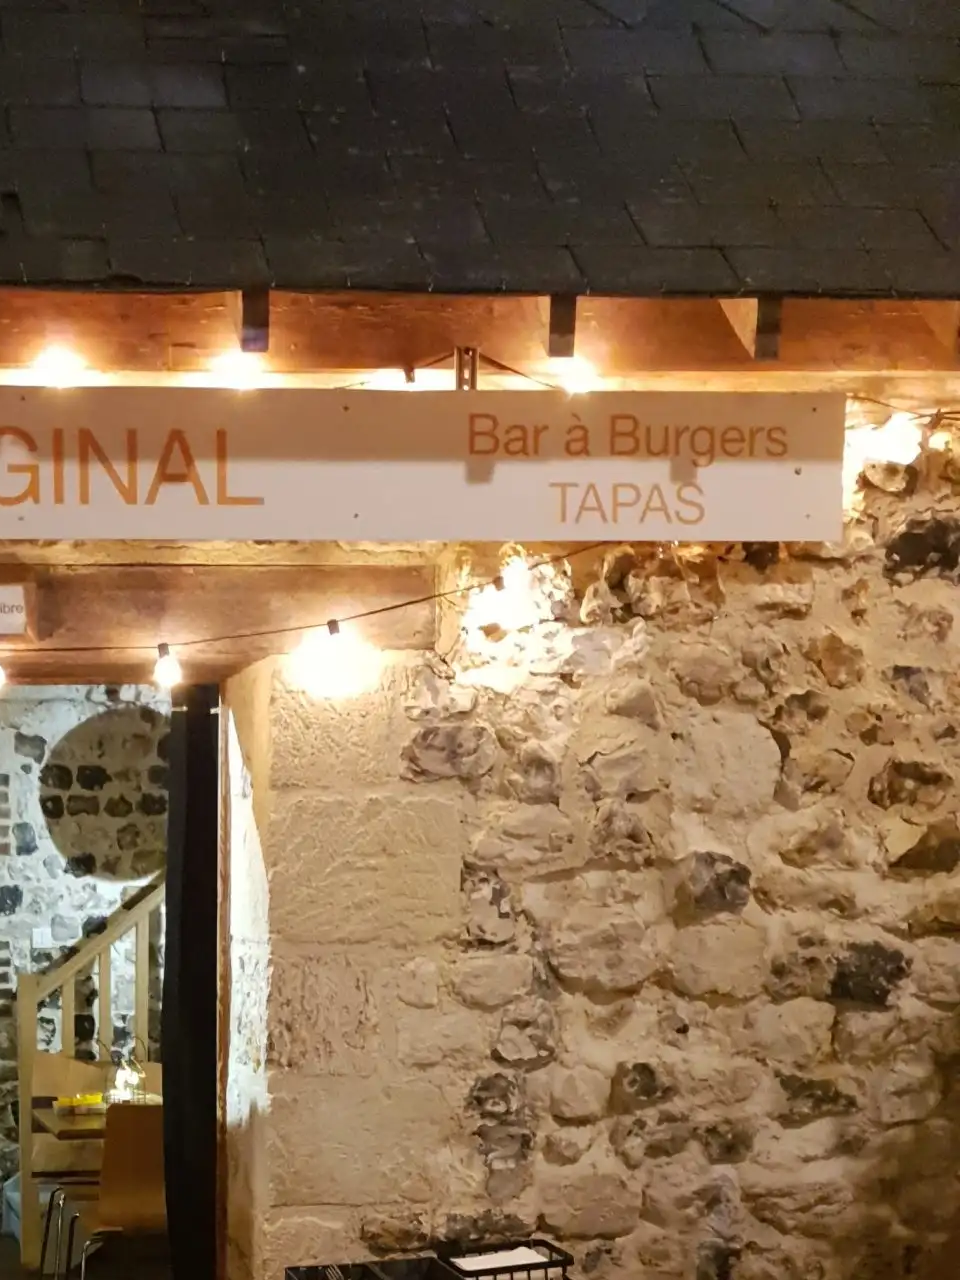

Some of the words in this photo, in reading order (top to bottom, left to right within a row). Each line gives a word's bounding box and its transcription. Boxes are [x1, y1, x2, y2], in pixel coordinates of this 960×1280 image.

[468, 413, 549, 457] Bar
[564, 413, 590, 457] à
[610, 414, 788, 467] Burgers
[549, 482, 705, 525] TAPAS
